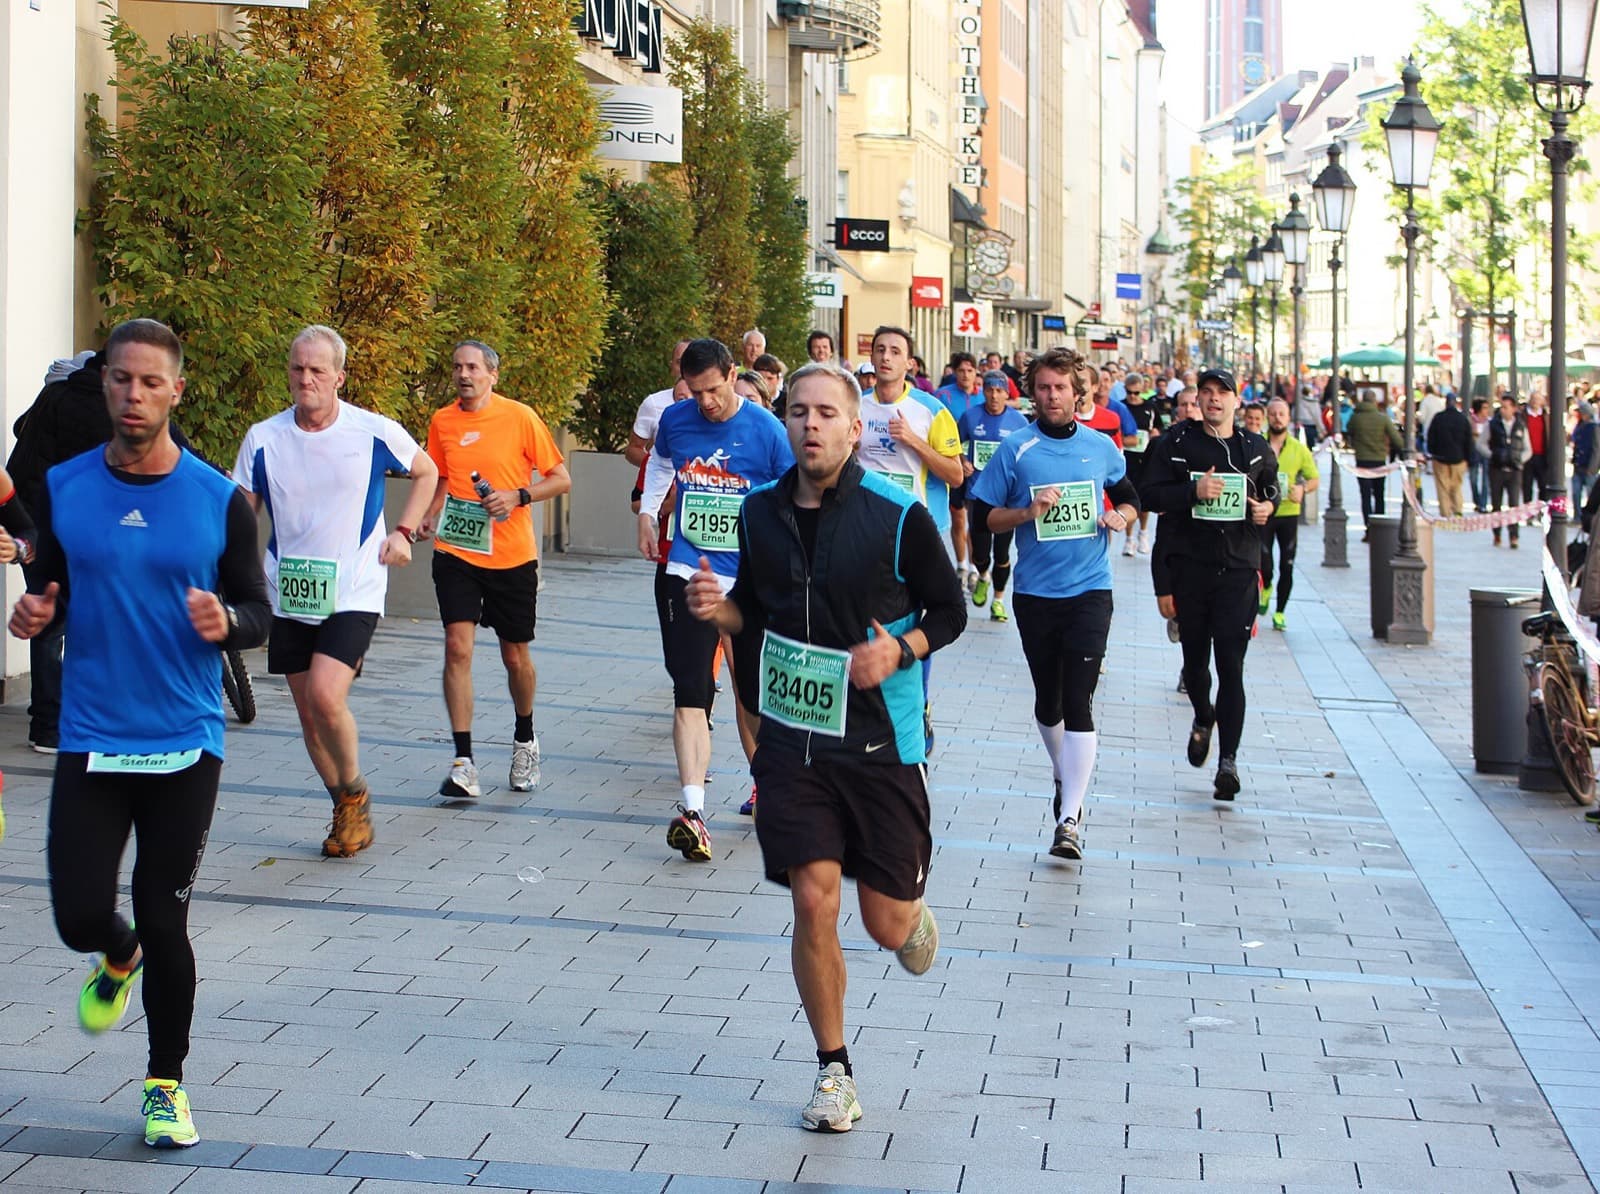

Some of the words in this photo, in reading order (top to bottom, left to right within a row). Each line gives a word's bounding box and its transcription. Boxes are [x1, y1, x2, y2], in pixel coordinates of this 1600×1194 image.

[961, 0, 977, 185] OTHEKE
[849, 229, 885, 241] ecco
[978, 452, 993, 463] 20
[677, 469, 751, 490] MÜNCHEN
[687, 511, 740, 535] 21957
[1043, 502, 1090, 524] 22315
[443, 514, 486, 538] 26297
[1055, 522, 1082, 533] Jonas
[701, 533, 726, 543] Ernst
[281, 576, 328, 601] 20911
[289, 598, 321, 610] Michael
[767, 643, 786, 656] 2013
[767, 665, 834, 711] 23405
[767, 694, 832, 724] Christopher
[120, 757, 168, 767] Stefan
